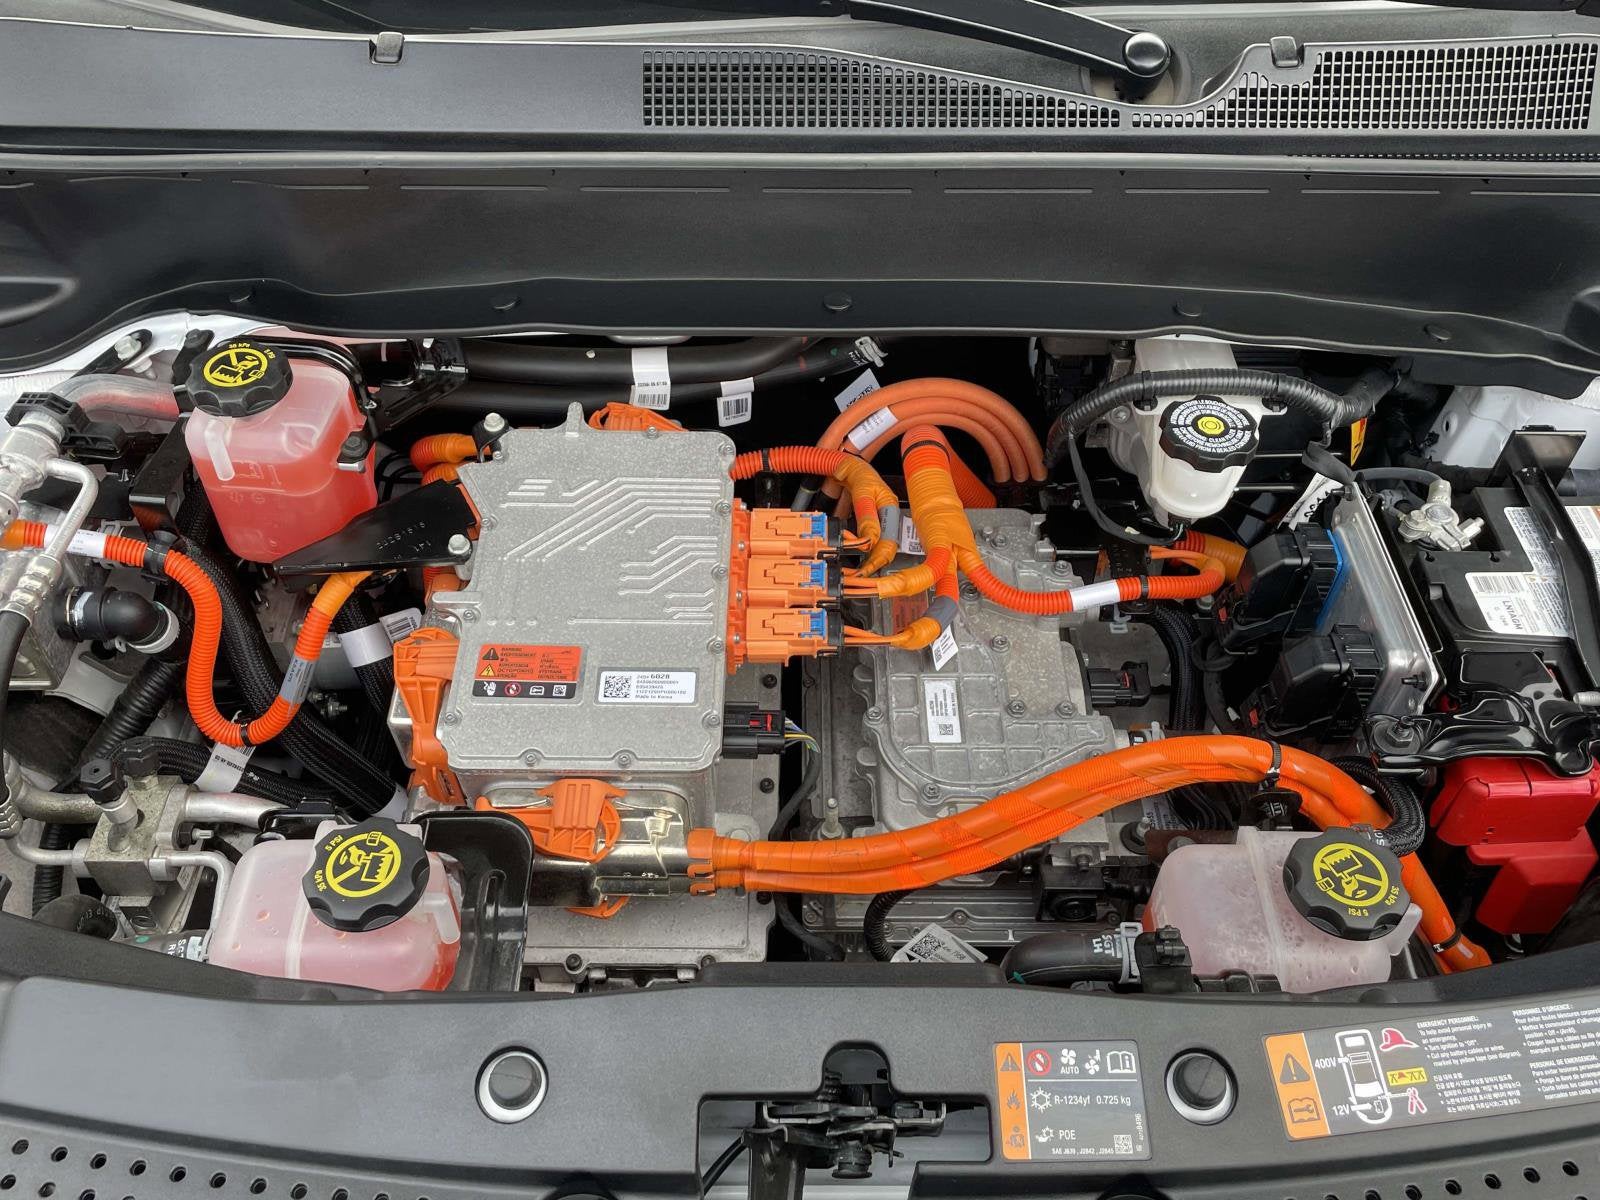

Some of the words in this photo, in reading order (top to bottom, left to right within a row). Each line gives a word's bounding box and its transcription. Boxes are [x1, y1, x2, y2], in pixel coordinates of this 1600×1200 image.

[330, 835, 344, 847] PSI
[1391, 885, 1400, 896] 35
[1348, 908, 1362, 917] PSI
[1093, 938, 1104, 953] LH
[1417, 1019, 1448, 1029] EMERGENCY
[1448, 1016, 1479, 1025] PERSONNEL:
[1426, 1027, 1438, 1036] help
[1438, 1026, 1451, 1034] avoid
[1451, 1025, 1472, 1034] personal
[1472, 1023, 1486, 1032] injury
[1441, 1052, 1449, 1060] any
[1450, 1049, 1468, 1058] battery
[1315, 1057, 1337, 1070] 400V
[1460, 1057, 1476, 1065] yellow
[1529, 1062, 1556, 1070] PERSONAL
[1060, 1066, 1080, 1075] AUTO
[1054, 1095, 1090, 1106] R-1234yf
[1097, 1095, 1119, 1105] 0.725
[1121, 1095, 1132, 1107] kg
[1332, 1104, 1350, 1116] 12V
[1059, 1130, 1076, 1140] POE
